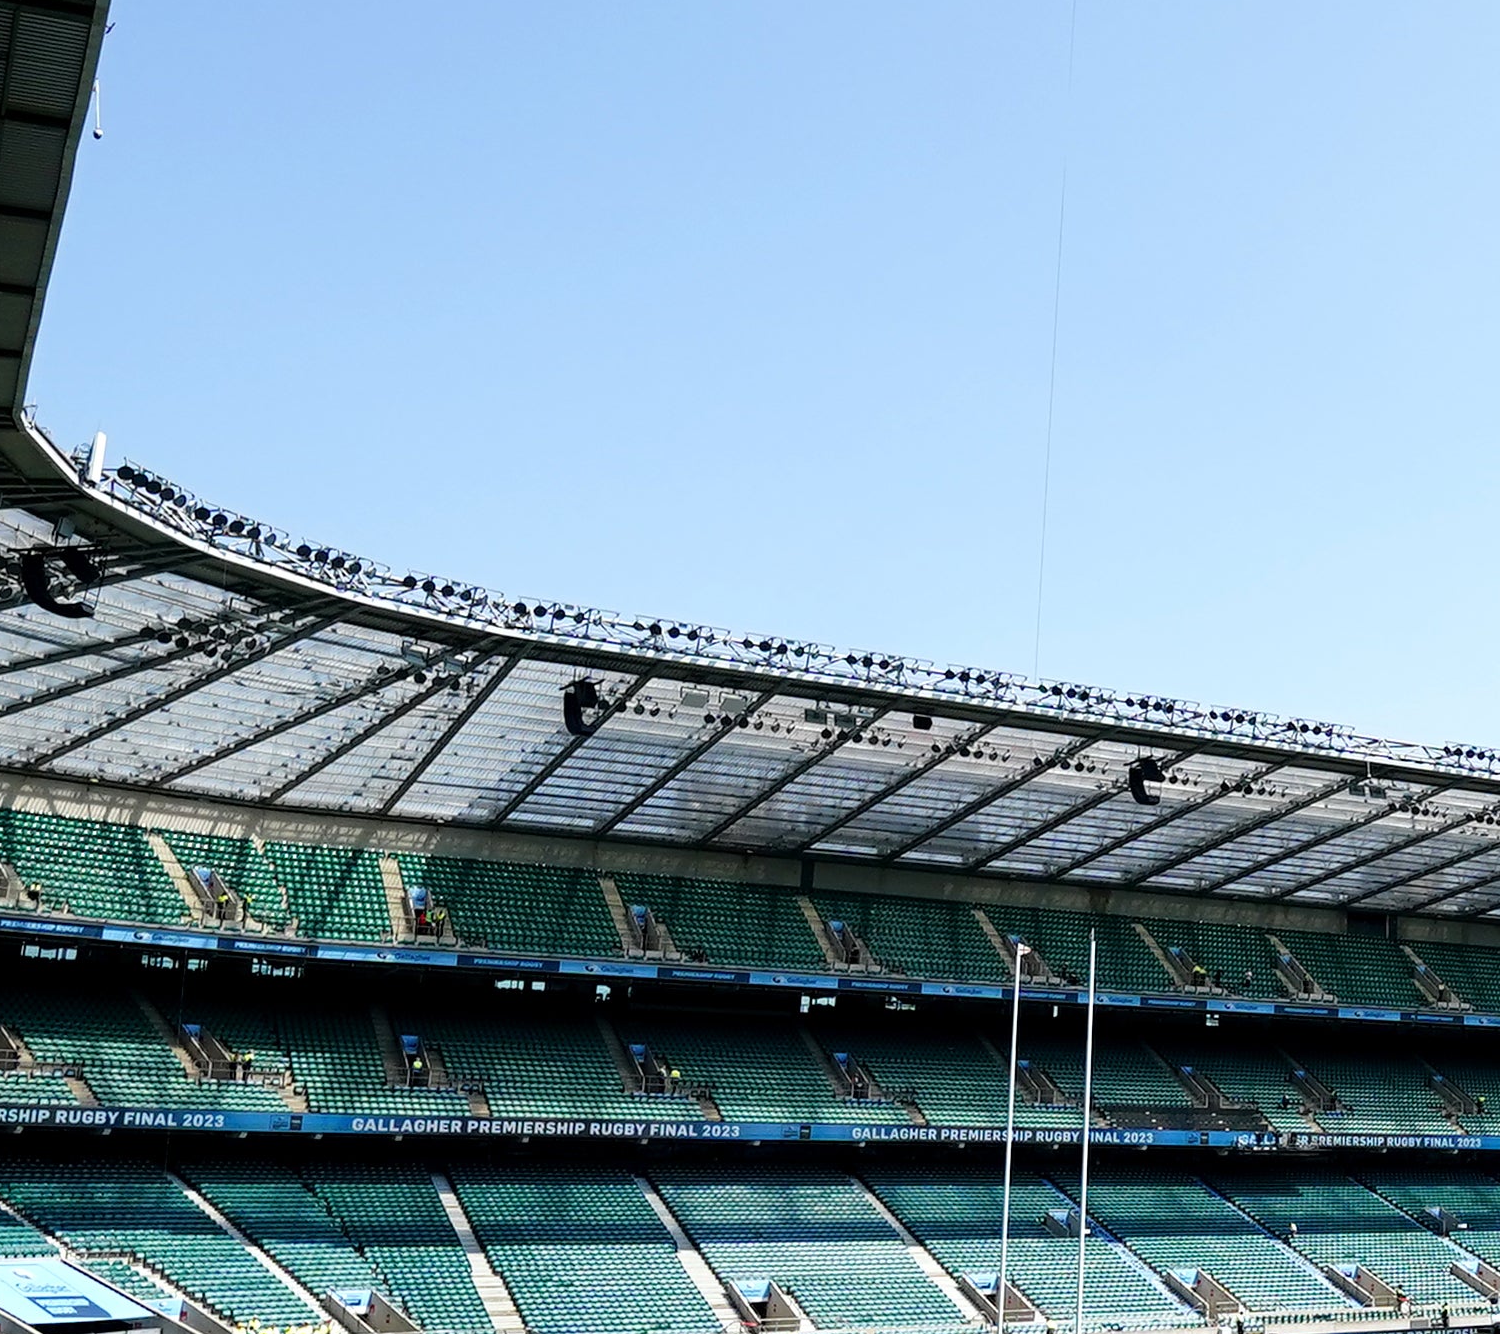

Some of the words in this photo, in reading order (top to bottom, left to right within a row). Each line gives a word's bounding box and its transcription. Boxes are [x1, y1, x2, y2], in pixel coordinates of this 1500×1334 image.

[55, 1109, 119, 1127] RUGBY
[124, 1112, 178, 1128] FINAL
[183, 1113, 225, 1129] 2023
[352, 1118, 463, 1134] GALLAGHER
[467, 1120, 585, 1136] PREMIERSHIP
[590, 1122, 646, 1137] RUGBY
[650, 1124, 698, 1138] FINAL
[702, 1125, 740, 1139] 2023
[852, 1128, 937, 1141] GALLAGHER
[941, 1129, 1033, 1143] PREMIERSHIP
[1038, 1131, 1080, 1144] RUGBY
[1089, 1132, 1120, 1144] INAL
[1124, 1133, 1154, 1145] 2023
[1387, 1137, 1422, 1148] RUGBY
[1425, 1137, 1455, 1148] FINAL
[1458, 1138, 1482, 1149] 2023
